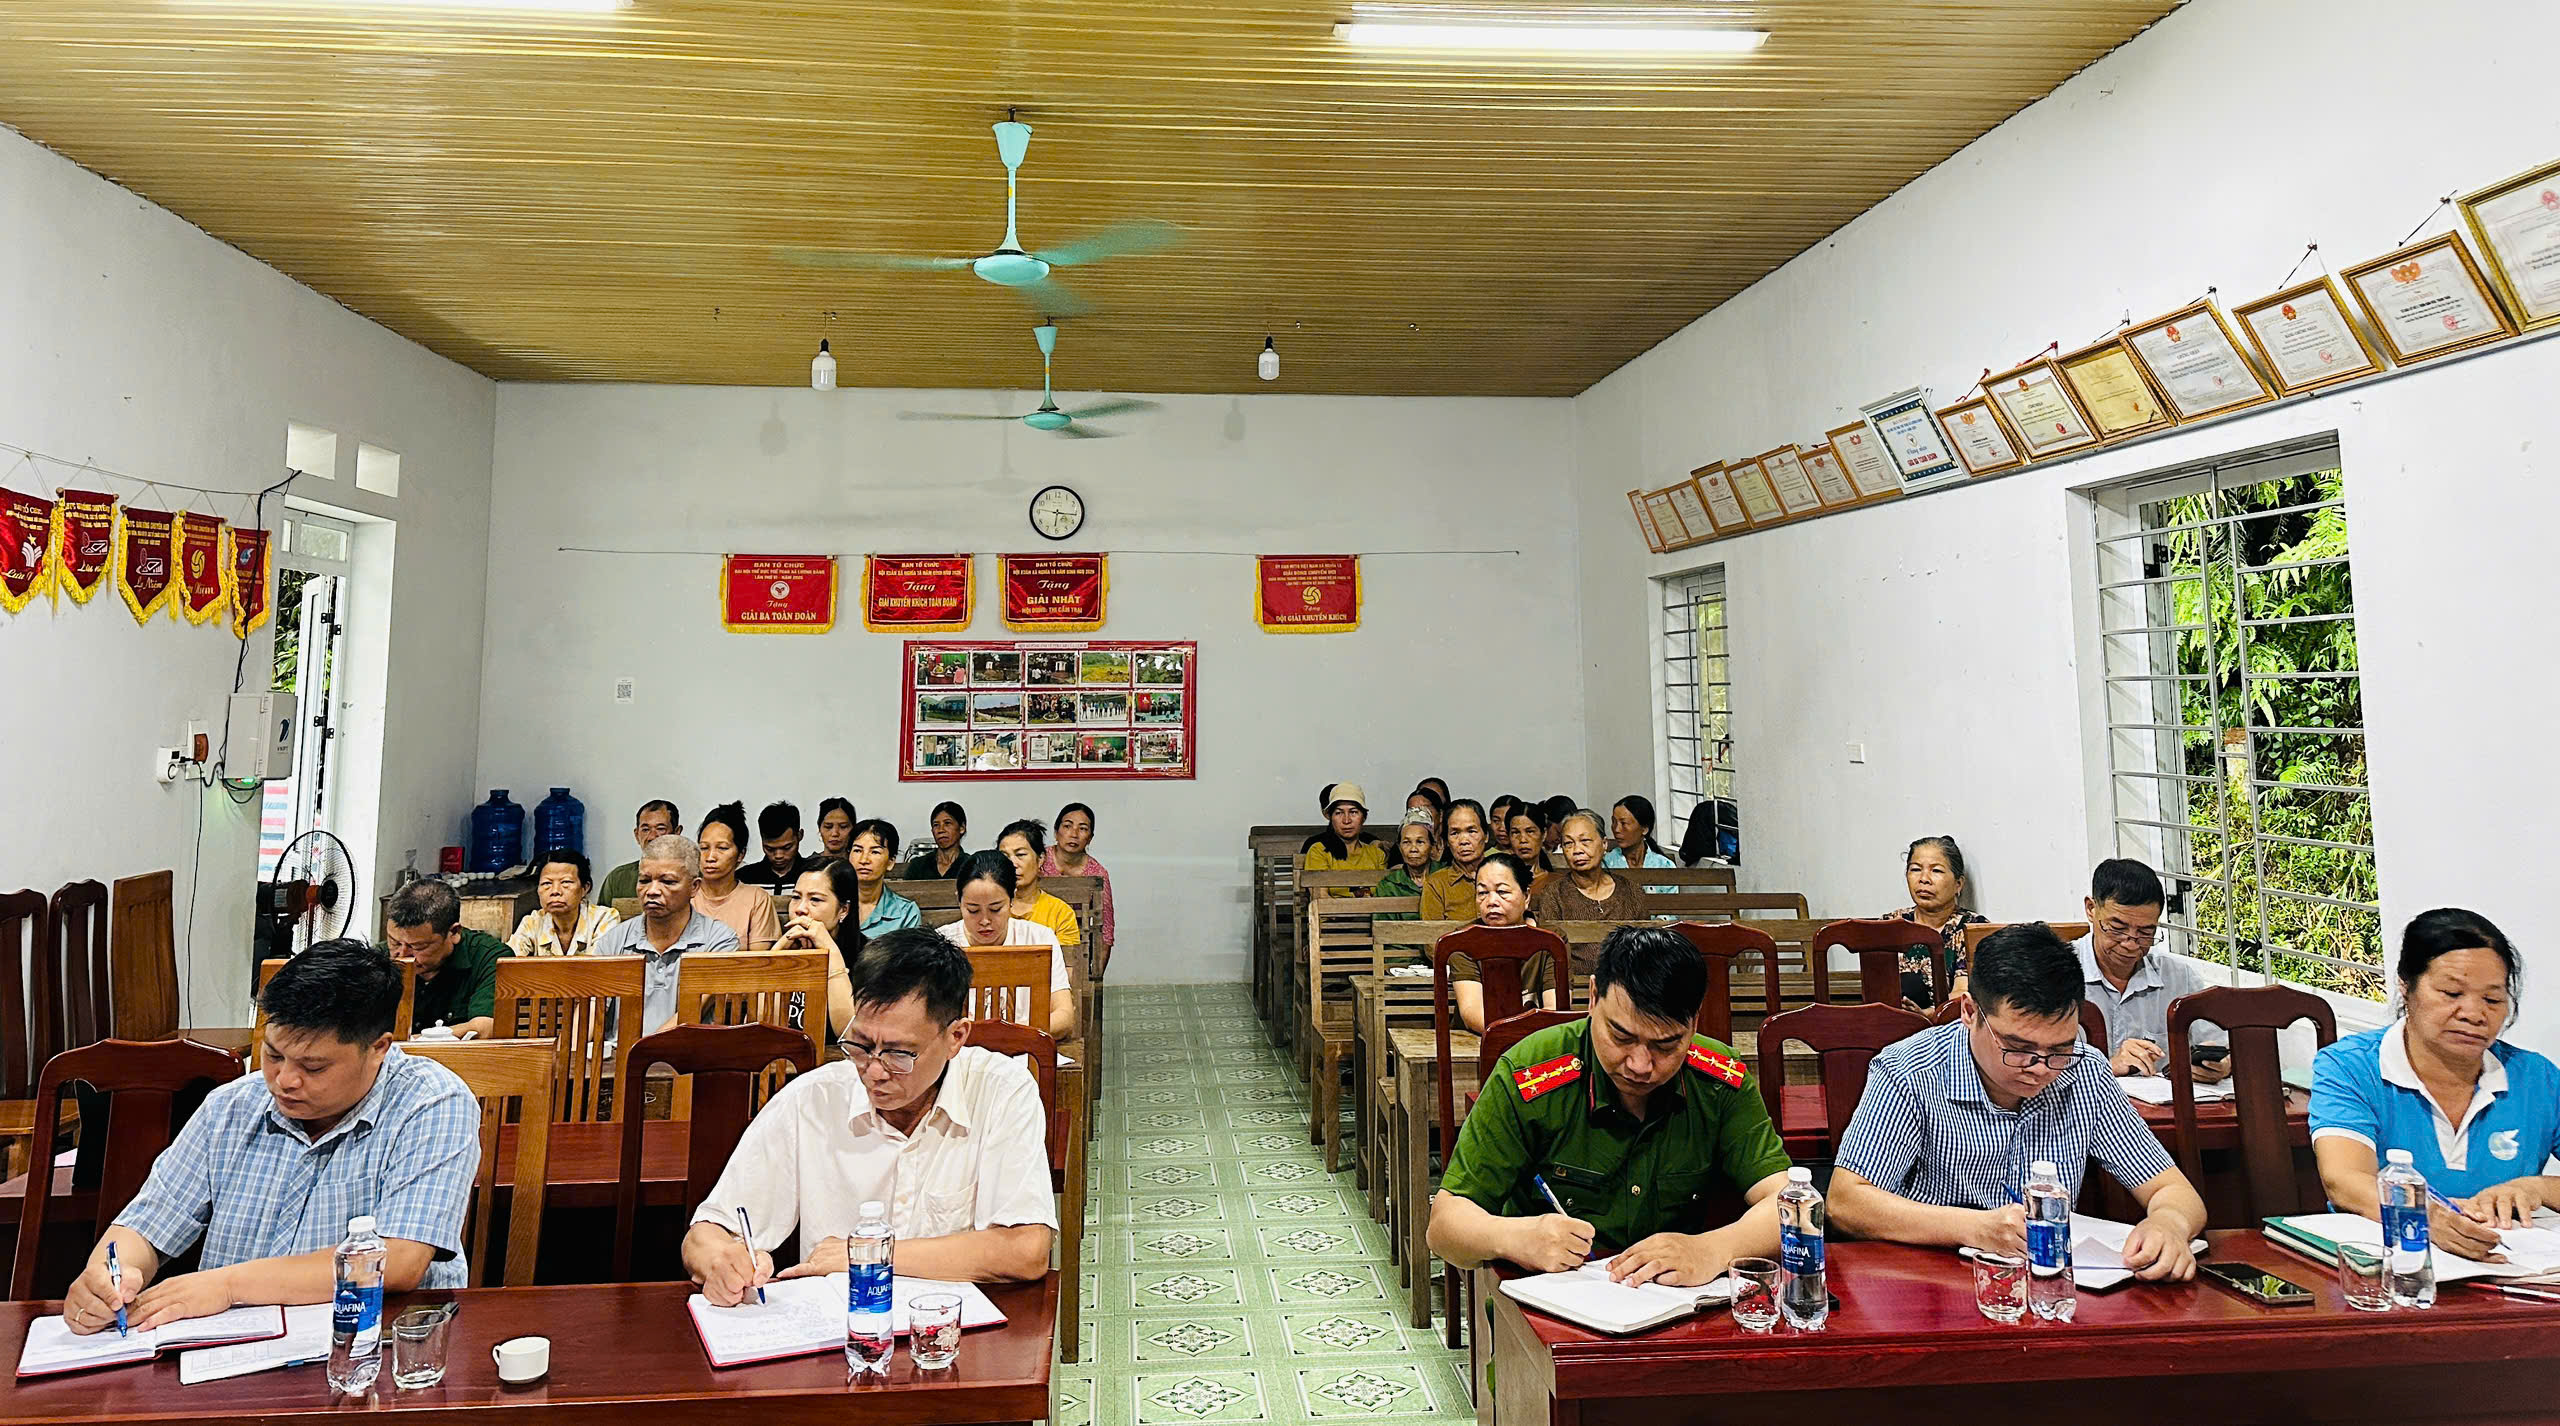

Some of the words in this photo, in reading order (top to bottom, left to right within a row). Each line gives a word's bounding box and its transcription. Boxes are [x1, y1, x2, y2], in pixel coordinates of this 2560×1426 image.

[1036, 580, 1070, 590] Tặng
[1027, 593, 1049, 604] GIẢI
[1052, 593, 1080, 604] NHẤT
[741, 609, 758, 620] GIẢI
[759, 612, 771, 620] BA
[772, 609, 793, 620] TOÀN
[794, 609, 817, 620] ĐOÀN
[1287, 612, 1301, 622] GIẢI
[1781, 1244, 1811, 1258] QUAFINA
[334, 1301, 367, 1315] QUAFINA
